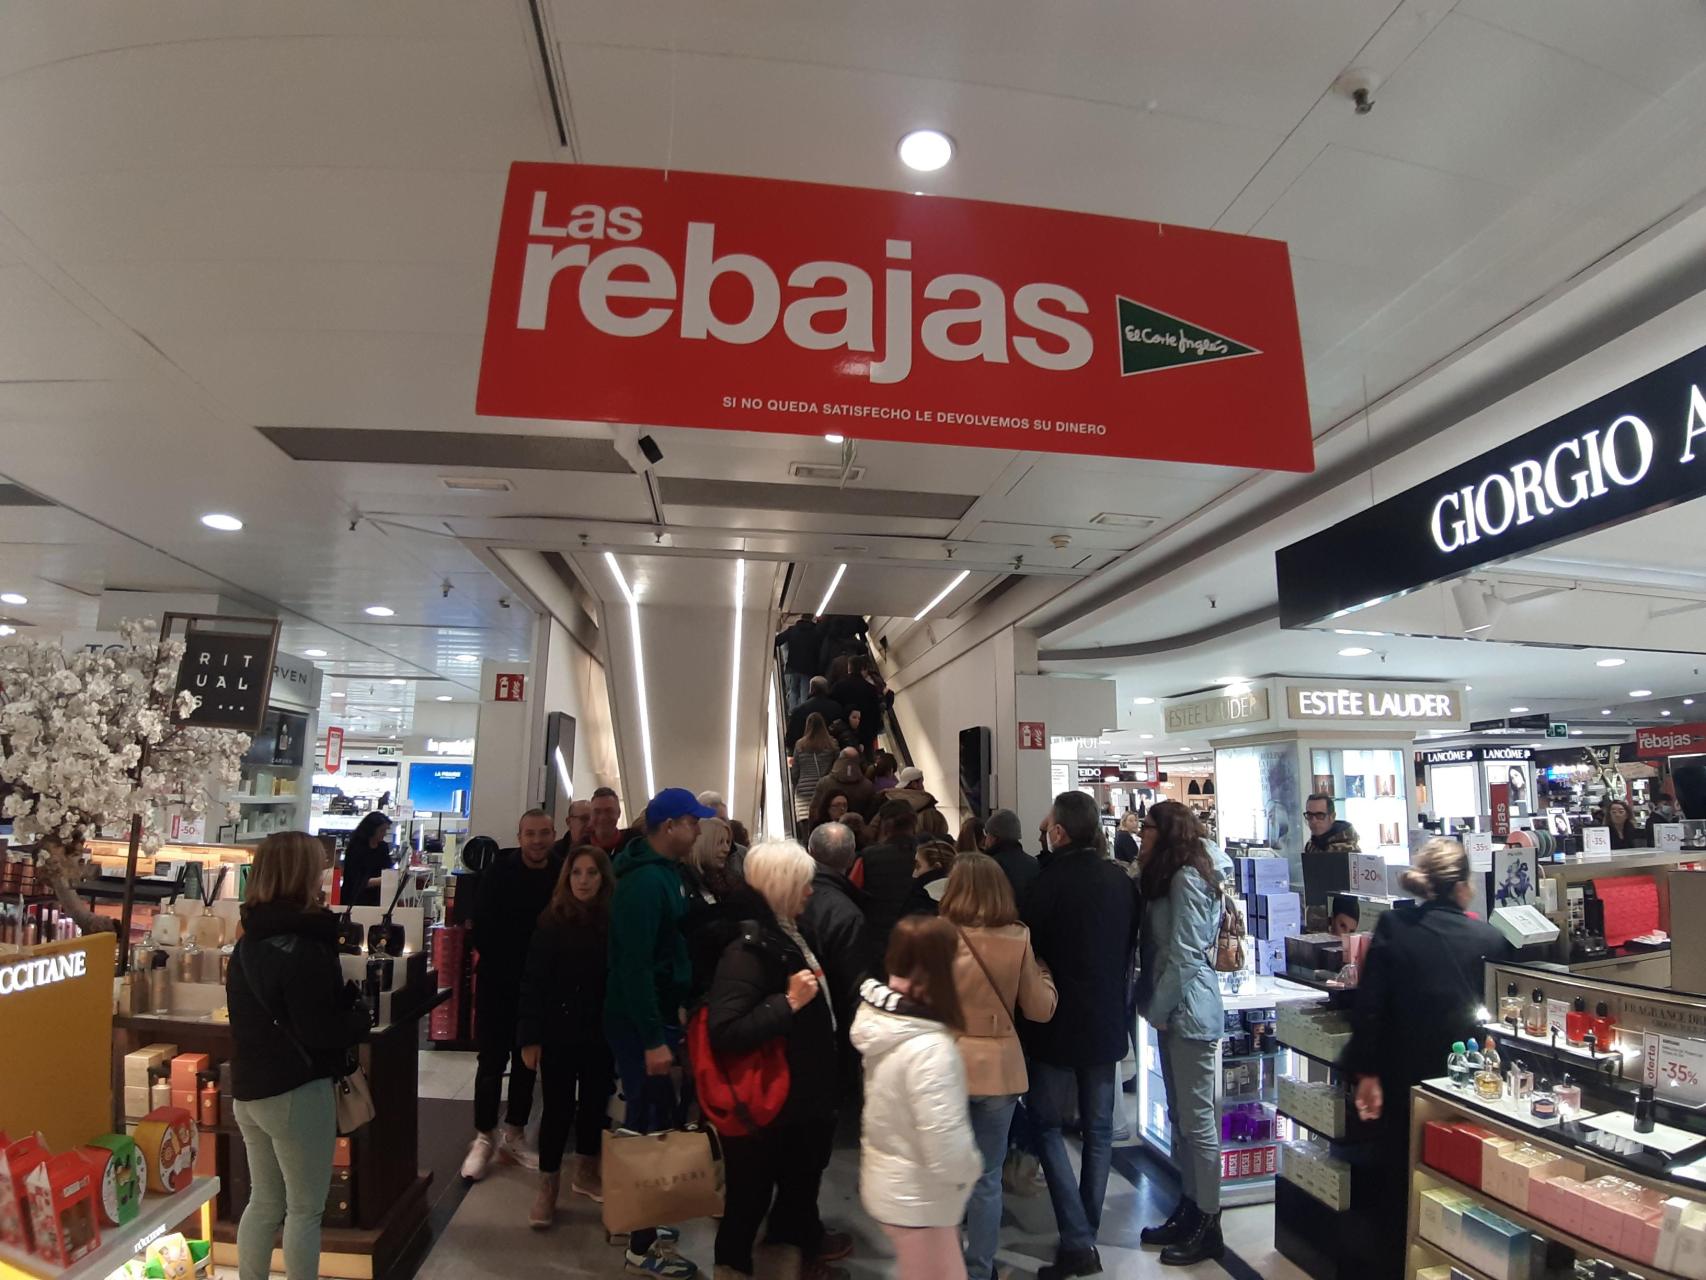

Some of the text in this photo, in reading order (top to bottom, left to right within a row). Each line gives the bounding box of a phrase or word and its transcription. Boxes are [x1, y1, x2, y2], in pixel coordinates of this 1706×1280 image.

[528, 191, 643, 241] Las
[516, 221, 1094, 384] rebajas
[1125, 325, 1141, 341] El
[1141, 328, 1177, 347] Corte
[722, 396, 1106, 435] SI NO QUEDA SATISFECHO LE DEVOLVEMOS SU DINERO
[1431, 414, 1654, 552] GIORGIO
[1368, 691, 1452, 717] LAUDER
[1483, 748, 1523, 759] LANCÔME
[1639, 732, 1691, 749] rebajas
[1428, 750, 1465, 762] LANCÔME
[1647, 1045, 1656, 1079] oferta
[1661, 1061, 1699, 1085] -35%
